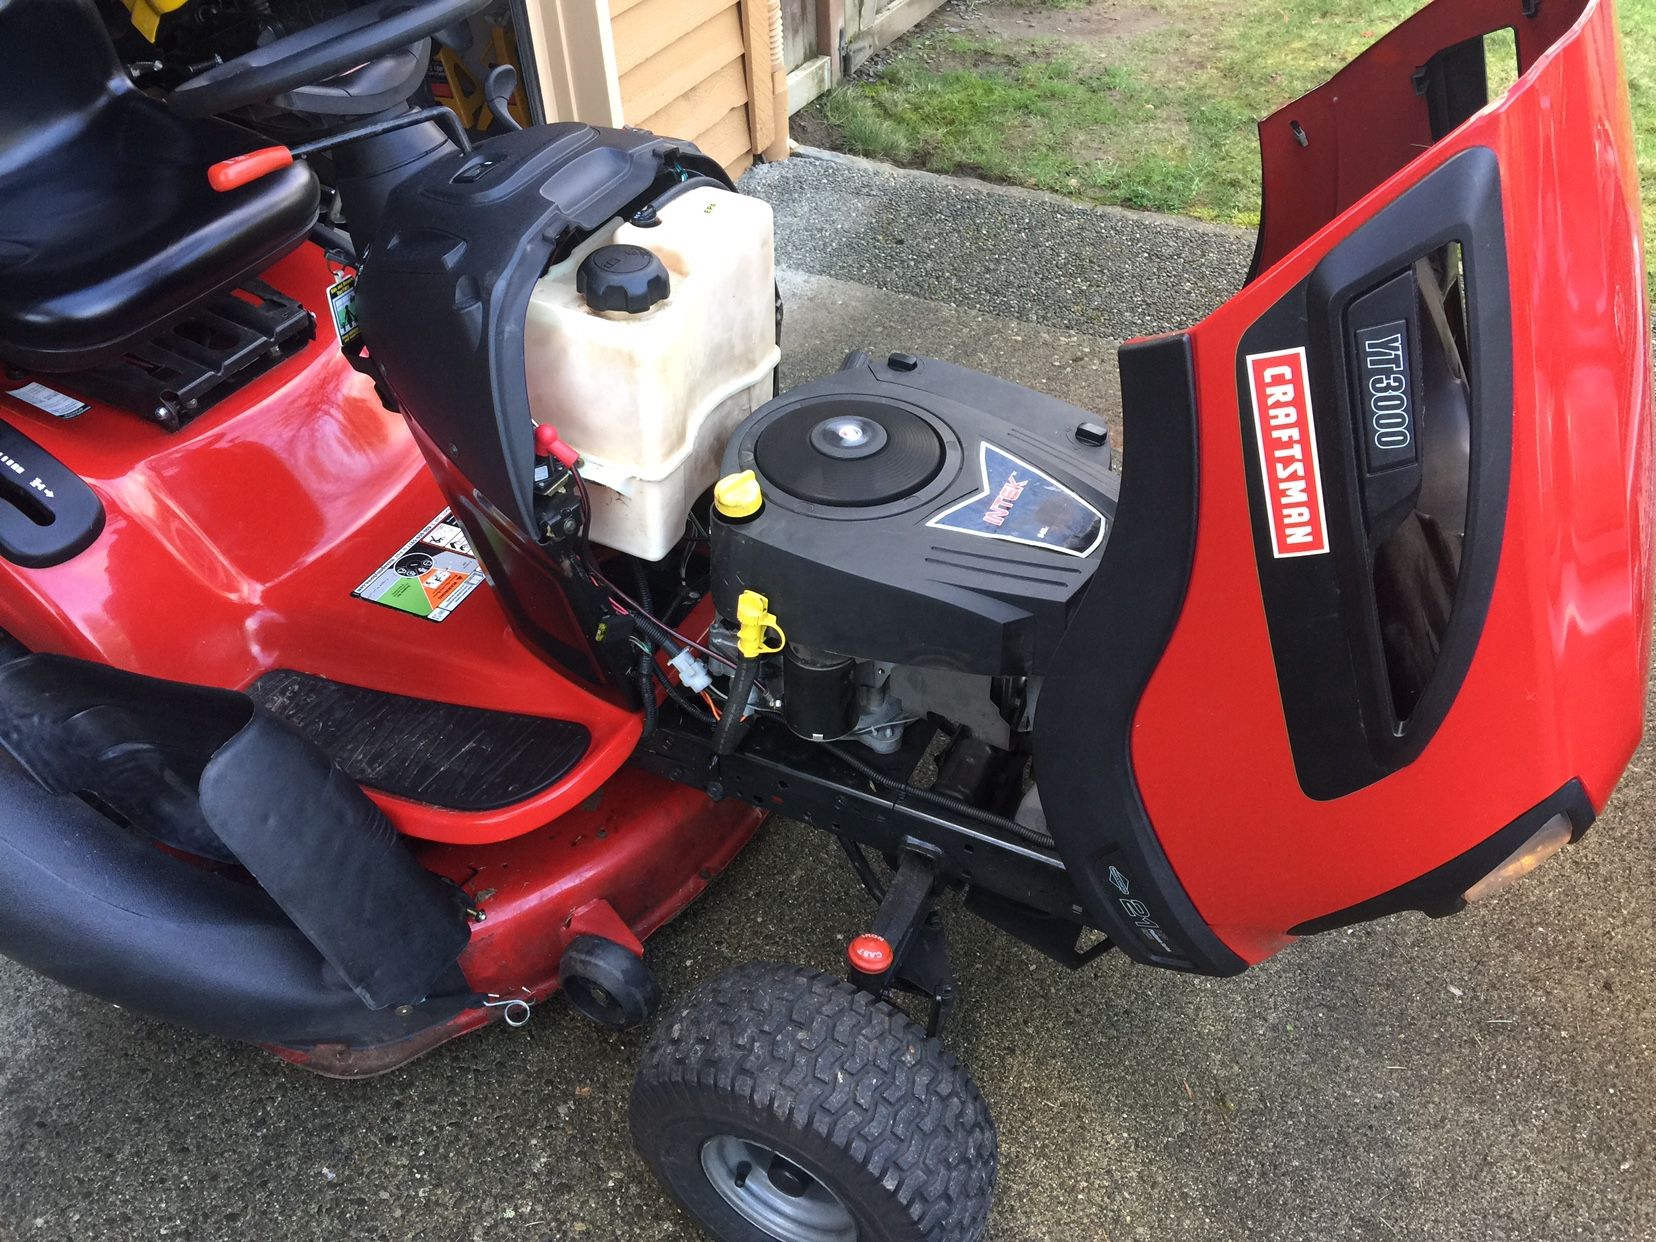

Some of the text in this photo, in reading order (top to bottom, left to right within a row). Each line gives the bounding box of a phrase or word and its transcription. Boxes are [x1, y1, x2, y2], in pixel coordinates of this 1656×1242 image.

[1365, 333, 1411, 449] YT 3000
[1263, 364, 1314, 545] CRAFTSMAN
[982, 474, 1029, 527] INTEK
[1119, 898, 1160, 929] 21
